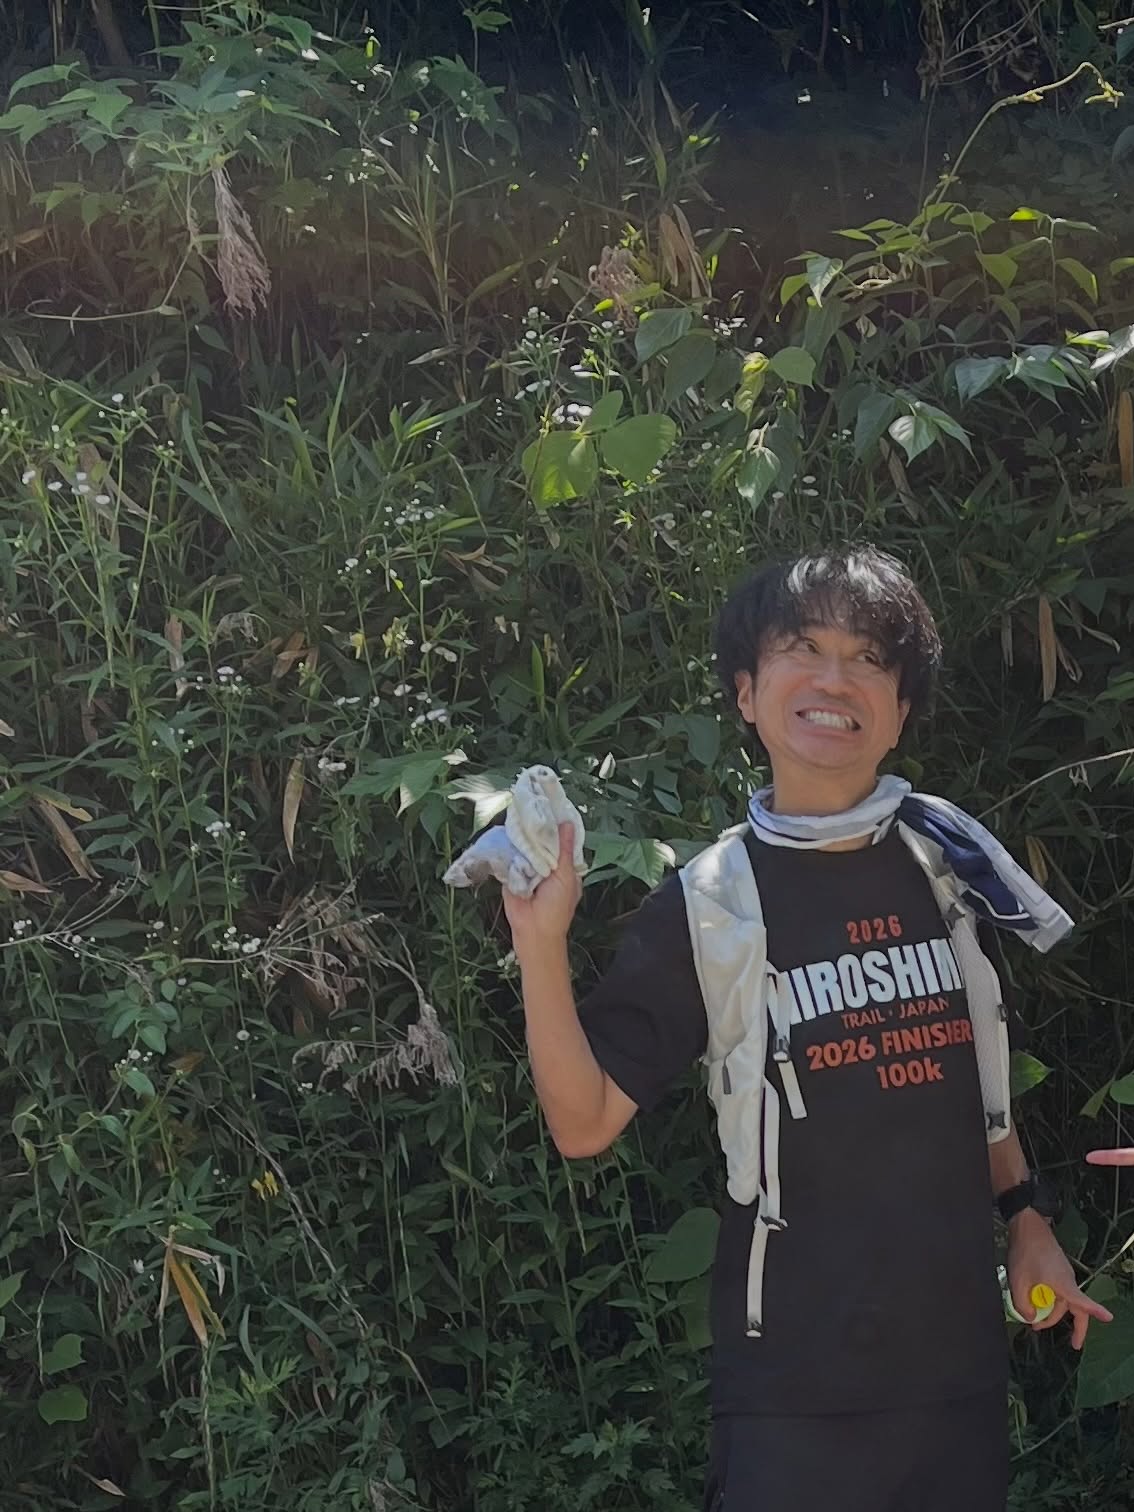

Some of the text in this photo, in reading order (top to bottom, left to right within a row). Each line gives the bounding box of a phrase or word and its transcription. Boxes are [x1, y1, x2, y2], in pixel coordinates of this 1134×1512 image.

[846, 915, 902, 944] 2026
[841, 996, 949, 1030] TRAIL JAPAN
[806, 1036, 877, 1071] 2026
[876, 1057, 944, 1090] 100k
